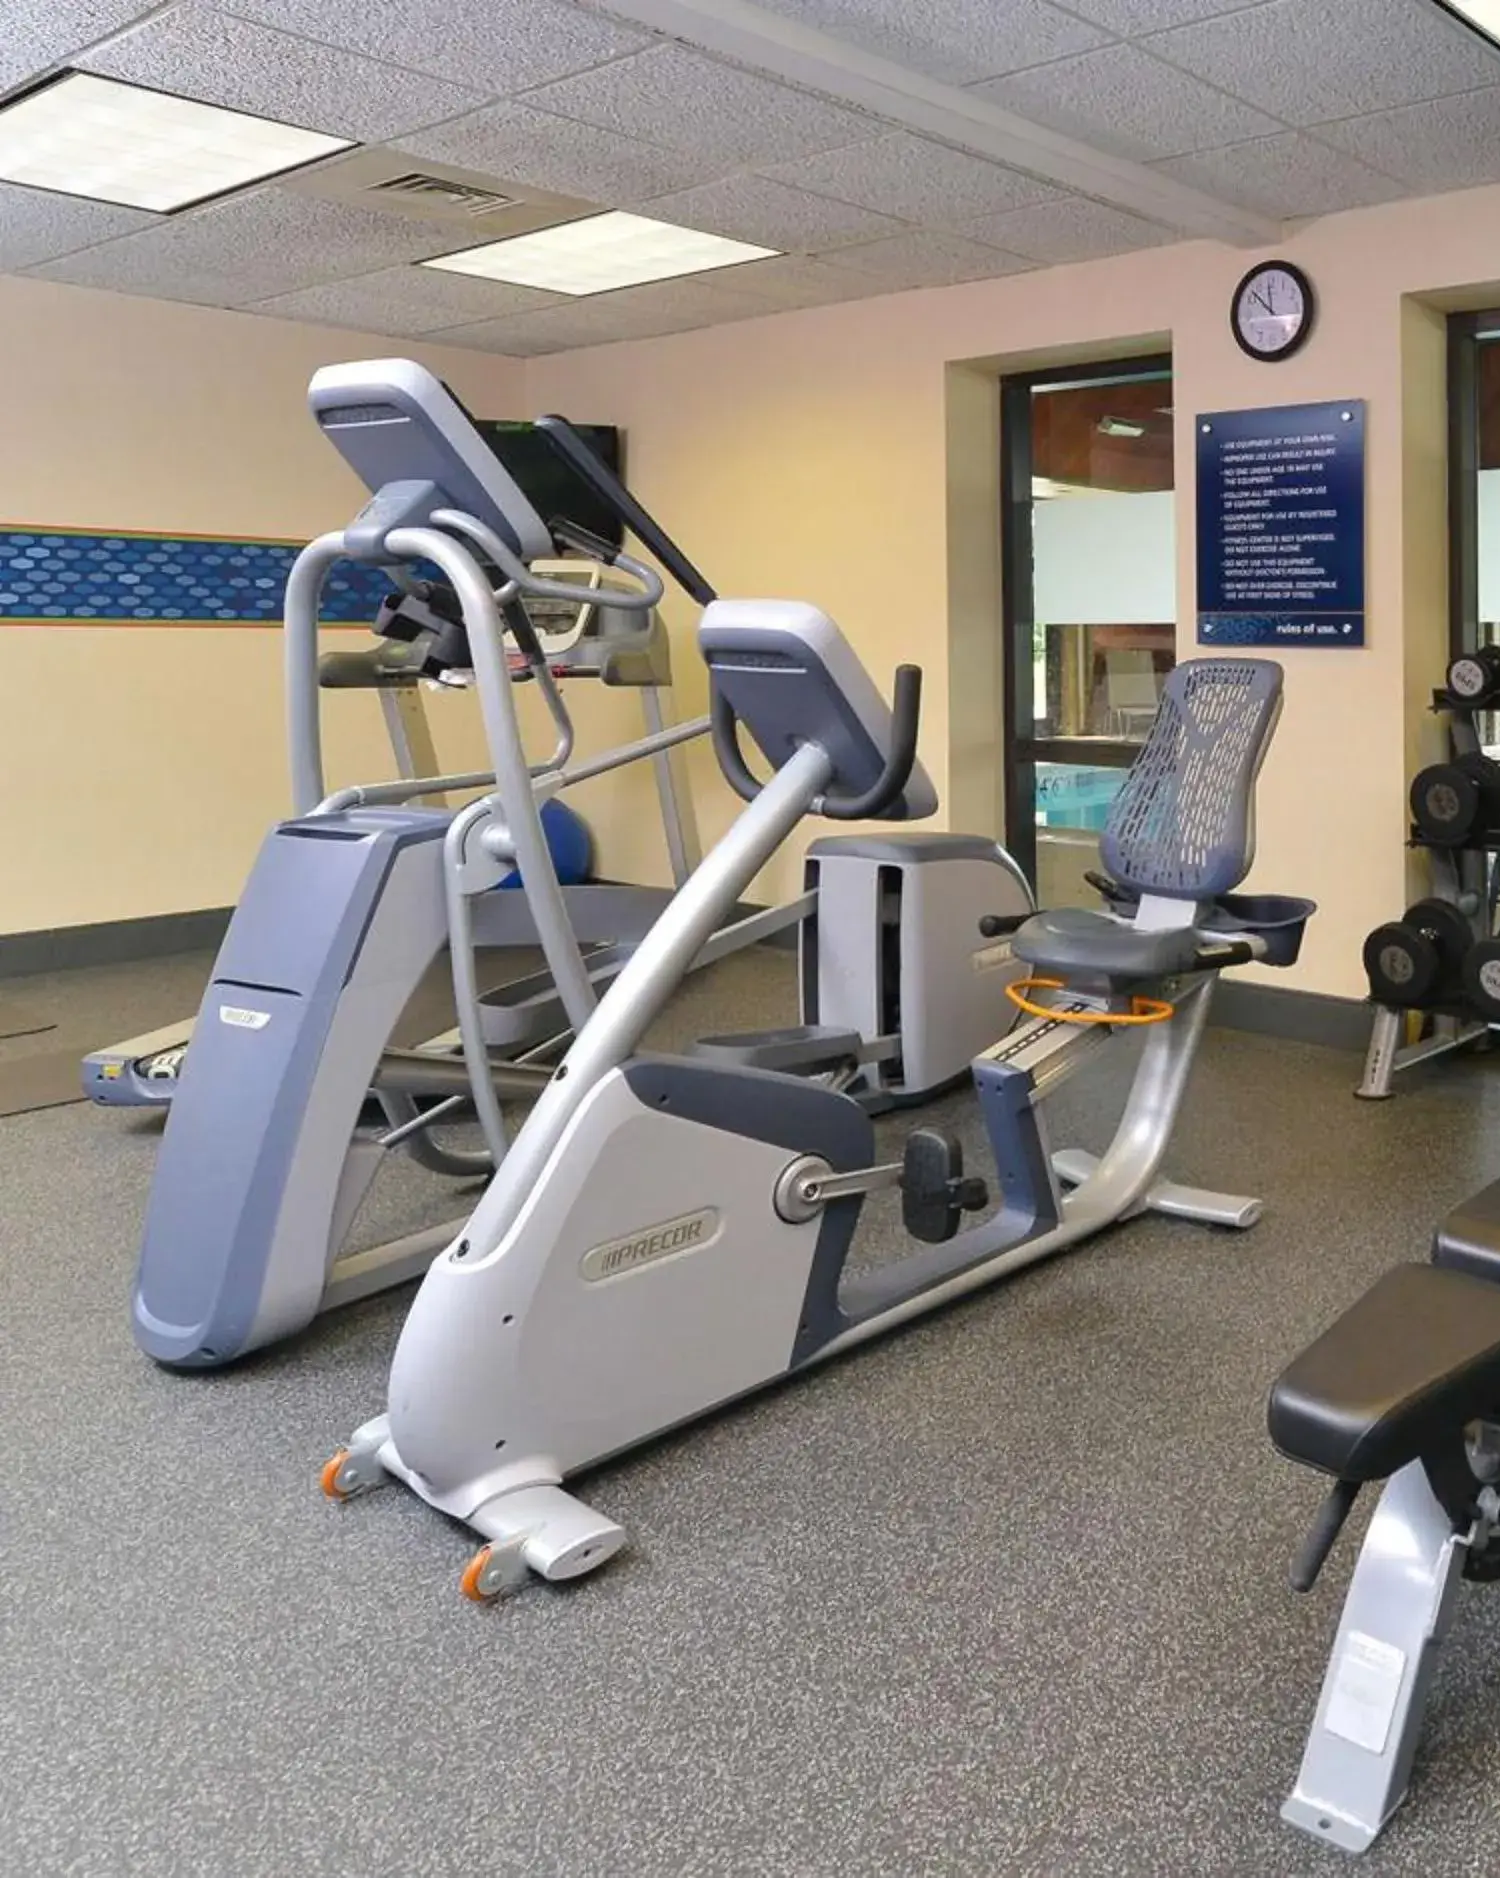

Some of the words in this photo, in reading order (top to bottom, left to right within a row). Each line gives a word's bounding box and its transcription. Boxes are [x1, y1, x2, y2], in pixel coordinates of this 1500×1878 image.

[1276, 622, 1301, 634] rules
[1303, 622, 1315, 634] of
[617, 1219, 703, 1267] PRECOR
